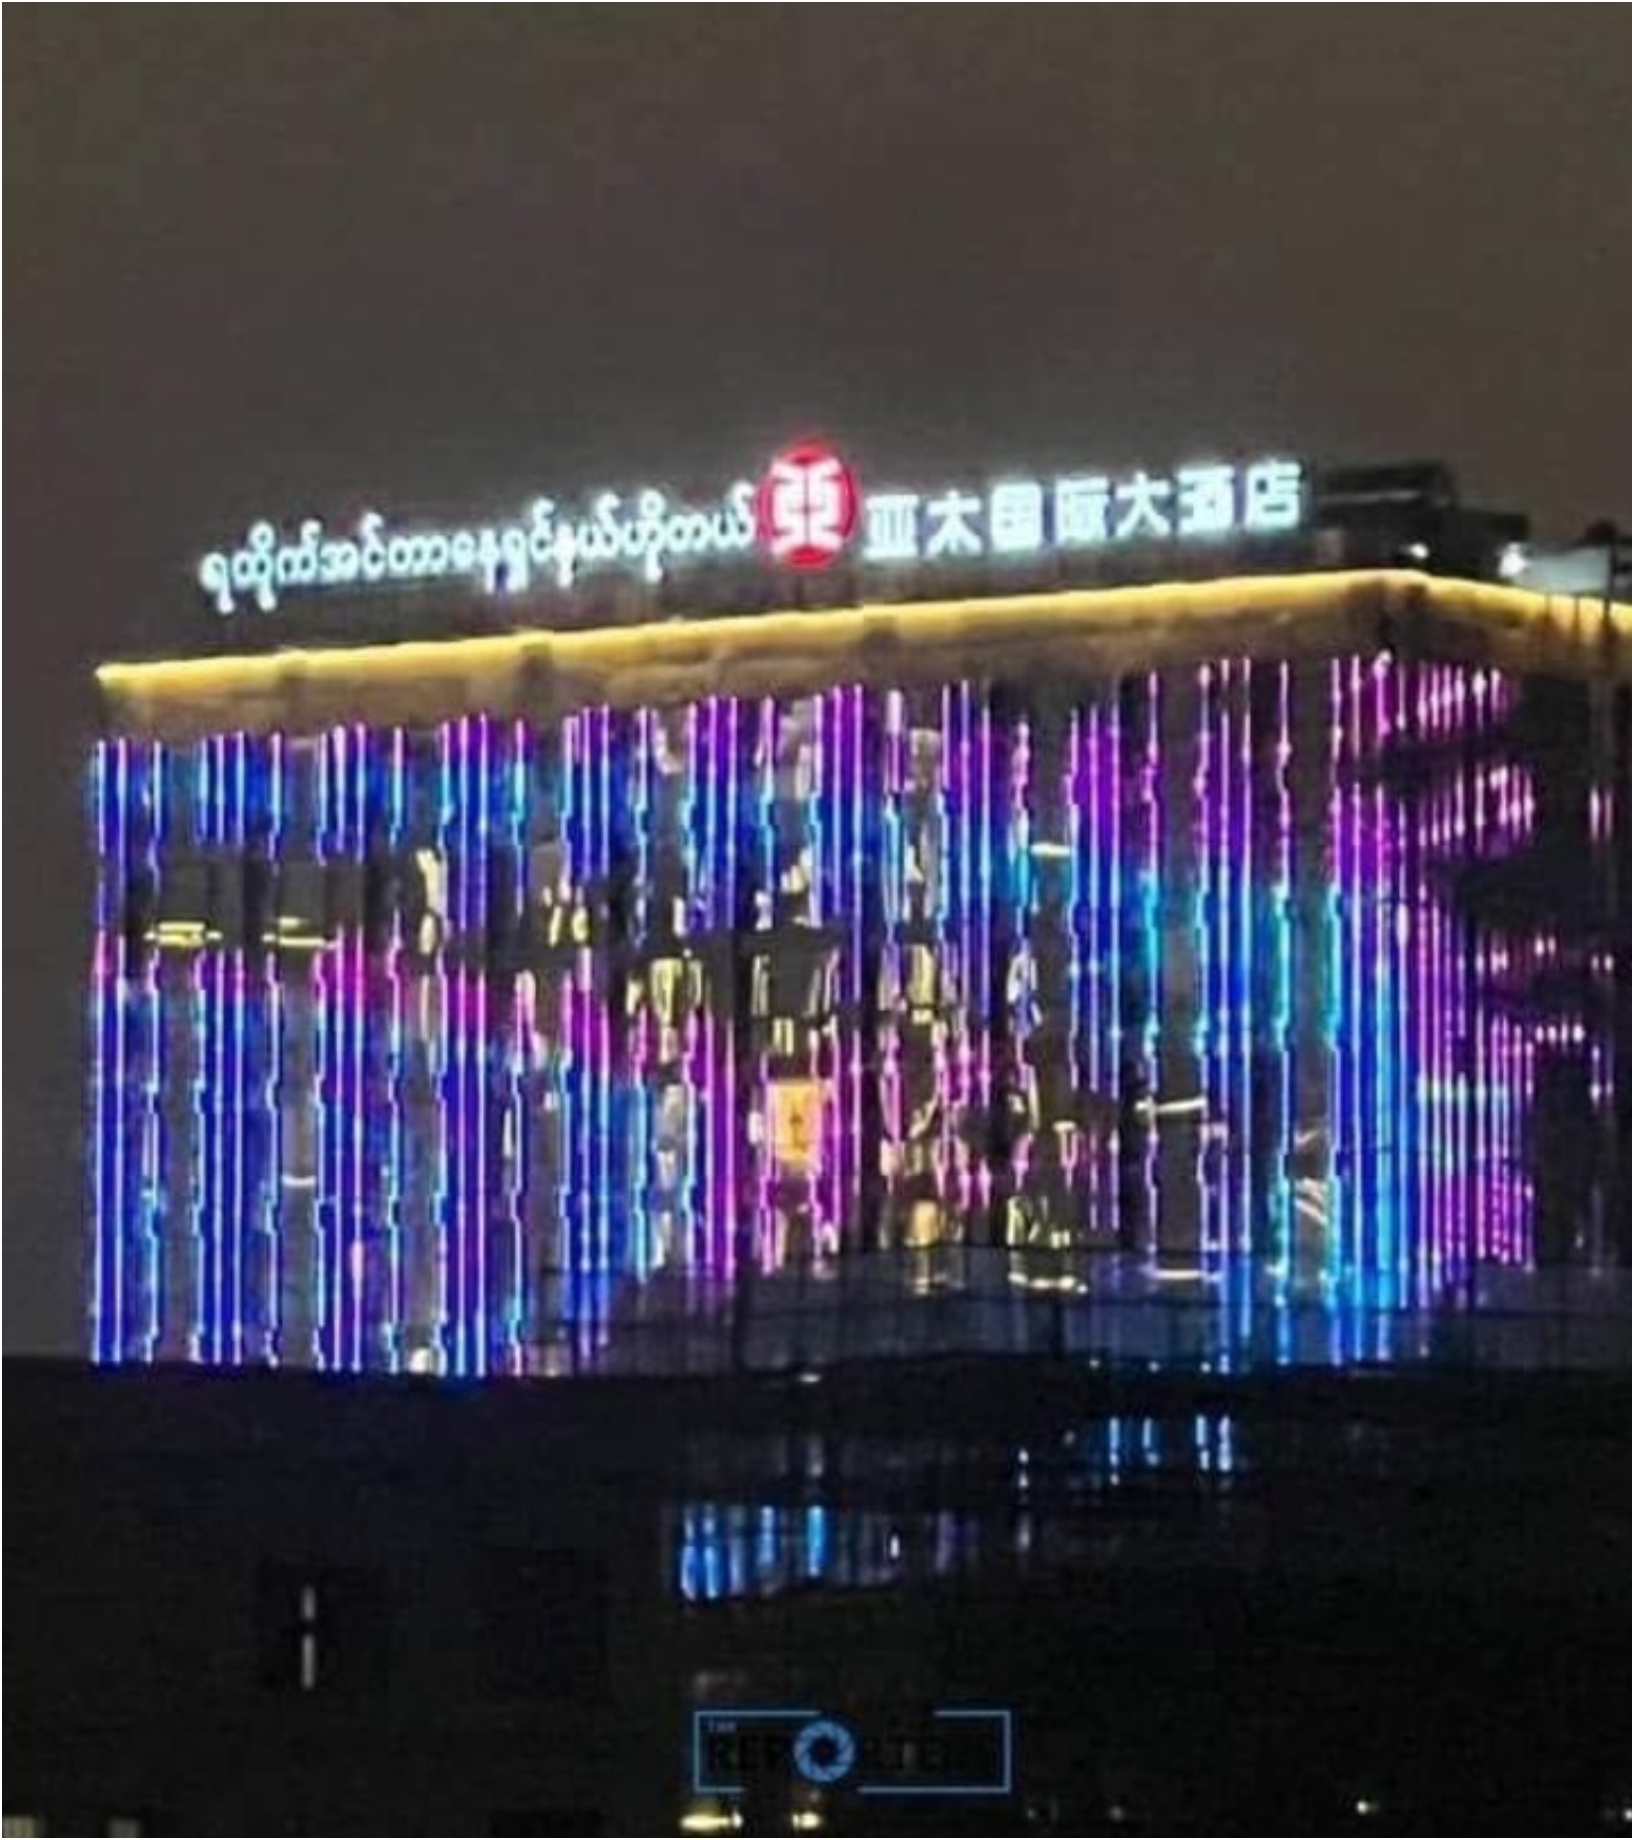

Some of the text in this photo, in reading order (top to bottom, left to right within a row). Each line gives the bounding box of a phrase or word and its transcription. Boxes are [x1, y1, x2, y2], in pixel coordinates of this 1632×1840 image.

[864, 459, 1302, 562] 亚太国际大酒店
